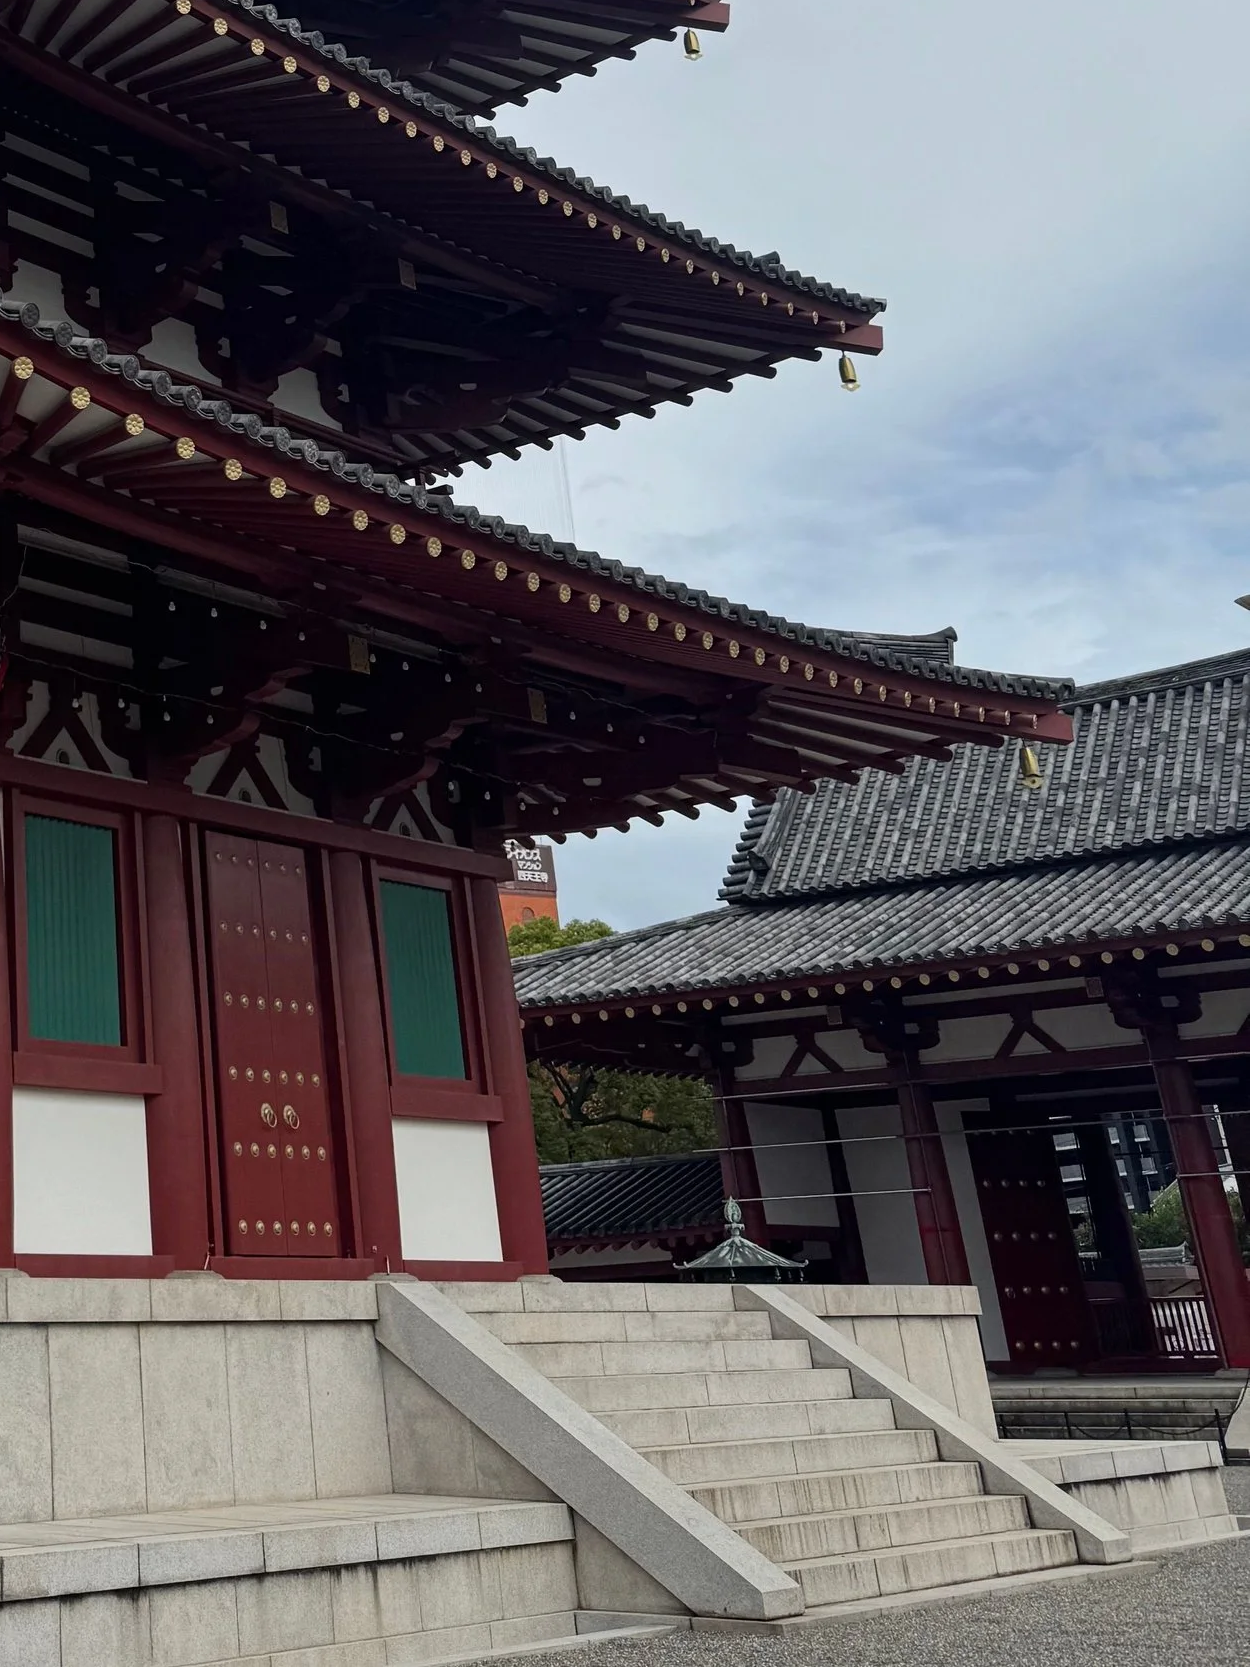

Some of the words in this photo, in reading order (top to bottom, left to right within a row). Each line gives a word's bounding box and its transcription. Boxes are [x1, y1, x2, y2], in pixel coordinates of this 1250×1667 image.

[517, 860, 542, 870] マンション
[517, 870, 548, 883] 四天王寺
